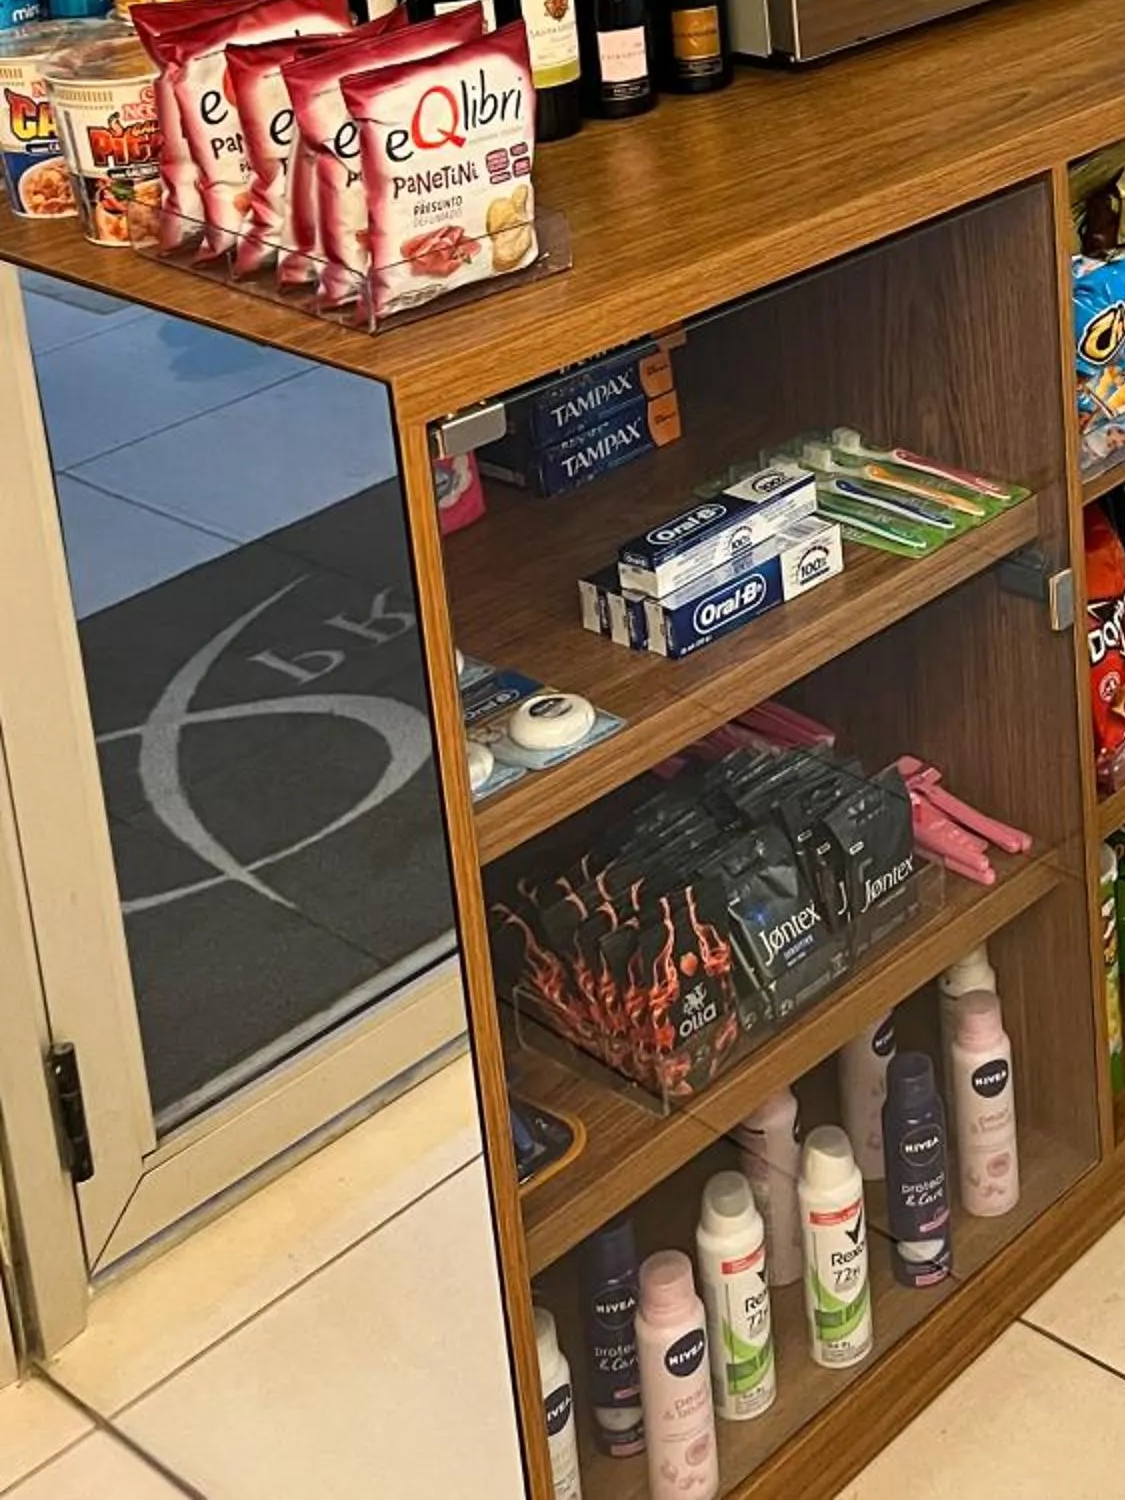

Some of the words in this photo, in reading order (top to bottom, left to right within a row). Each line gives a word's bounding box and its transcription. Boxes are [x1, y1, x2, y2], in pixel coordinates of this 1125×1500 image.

[385, 68, 523, 163] eQlibri
[550, 370, 633, 429] TAMPAX
[560, 419, 641, 478] TAMPAX
[699, 581, 759, 623] Oral-B
[974, 1070, 1008, 1088] NIVEA
[904, 1135, 940, 1154] NIVEA
[595, 1296, 637, 1314] NIVEA
[668, 1340, 705, 1367] NIVEA
[545, 1394, 572, 1421] IVEA
